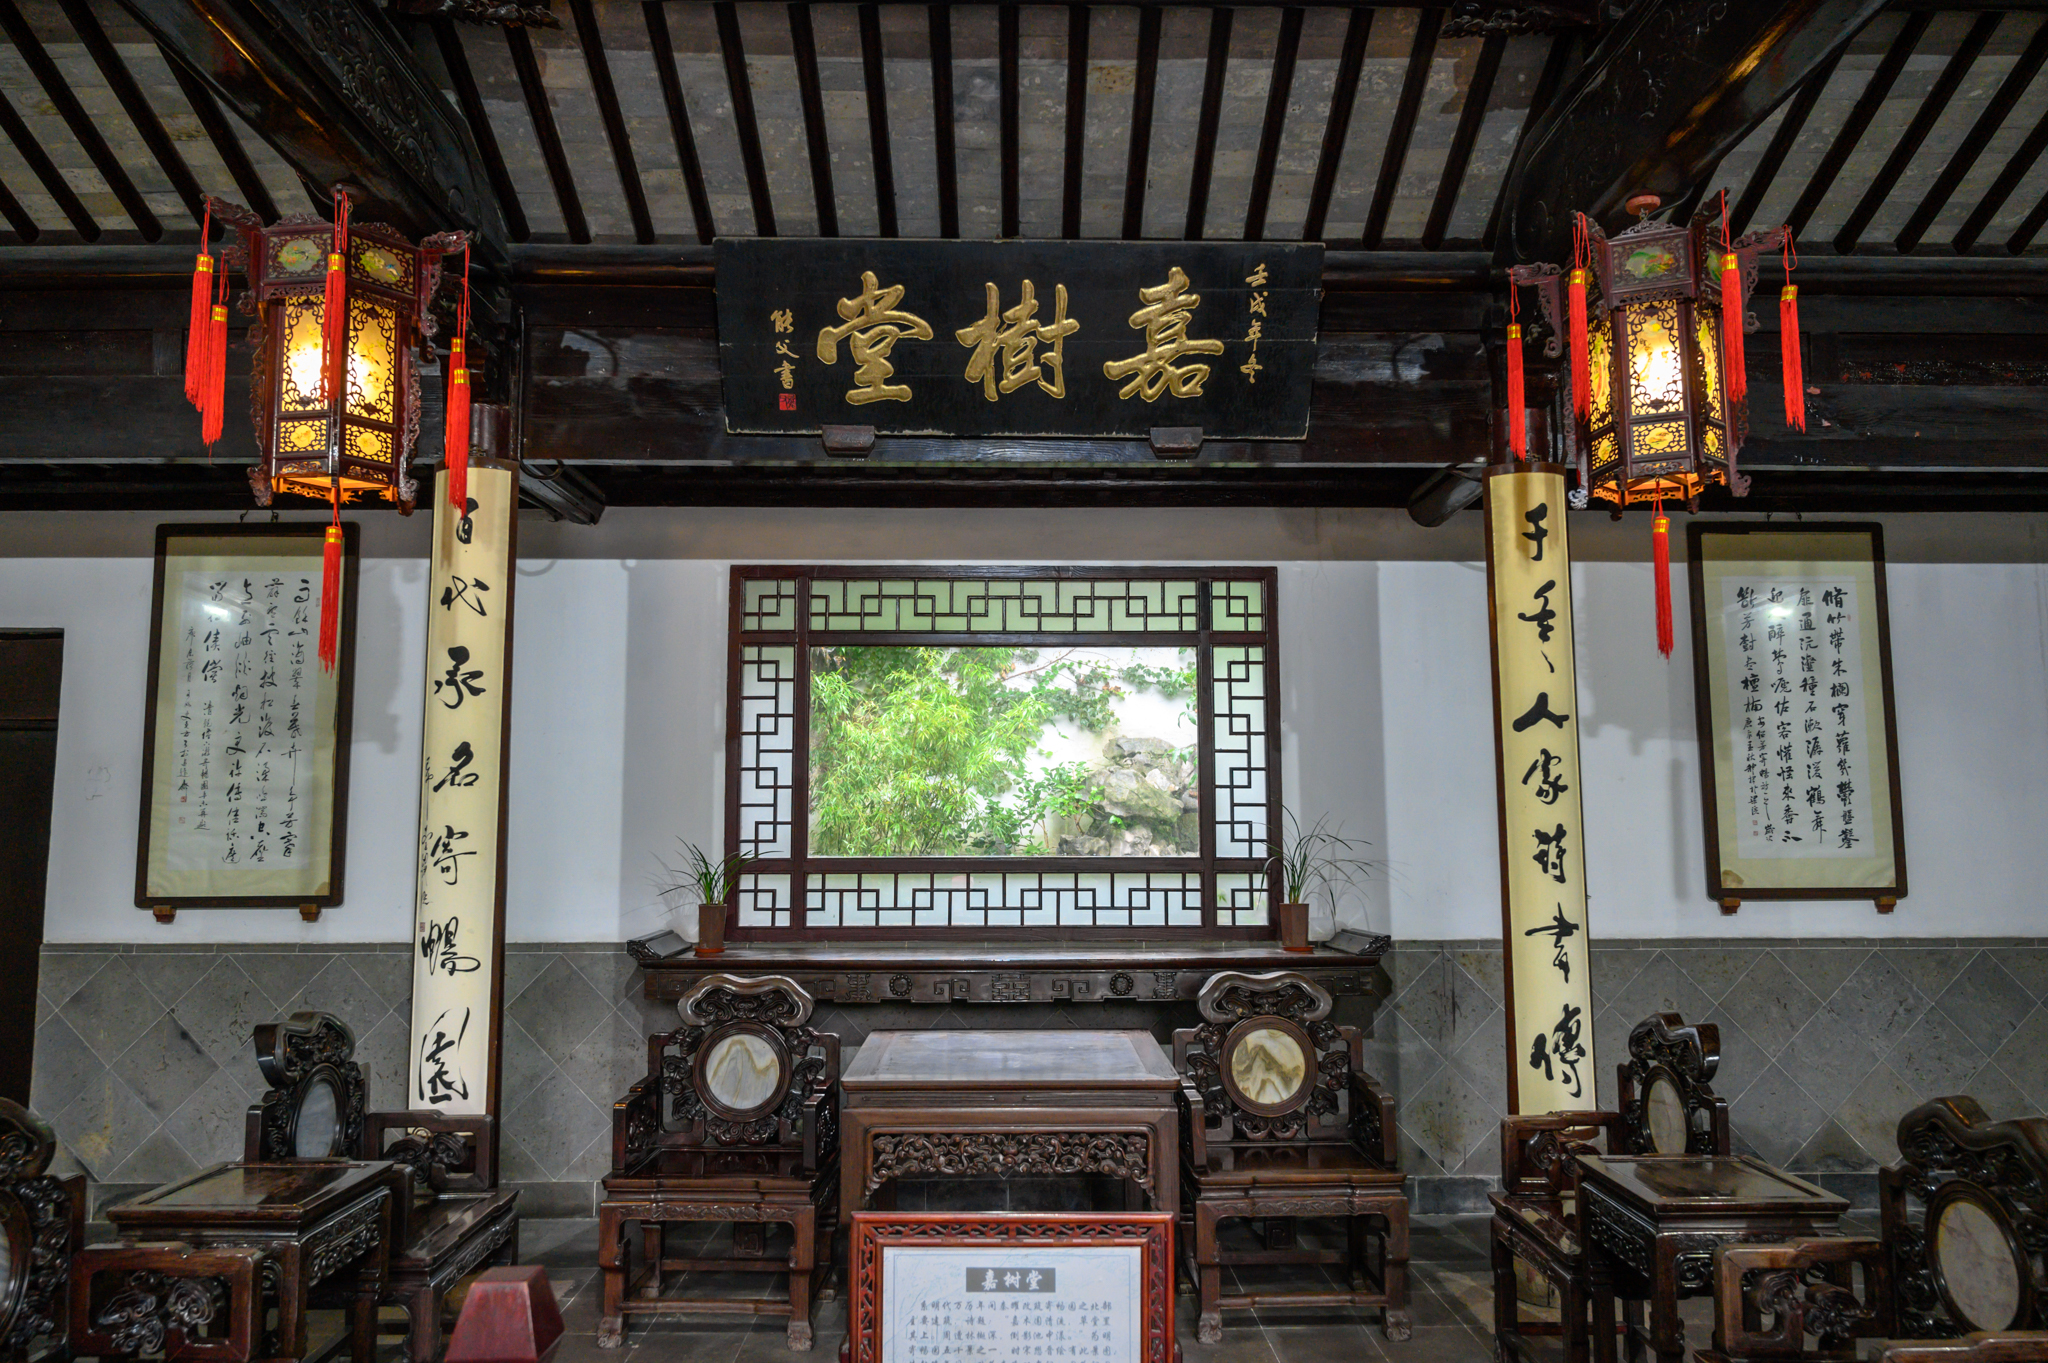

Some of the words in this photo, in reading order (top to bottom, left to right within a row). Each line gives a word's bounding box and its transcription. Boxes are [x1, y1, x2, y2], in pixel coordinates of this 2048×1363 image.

[816, 266, 1225, 405] 嘉樹堂
[981, 1268, 1043, 1291] 嘉树堂
